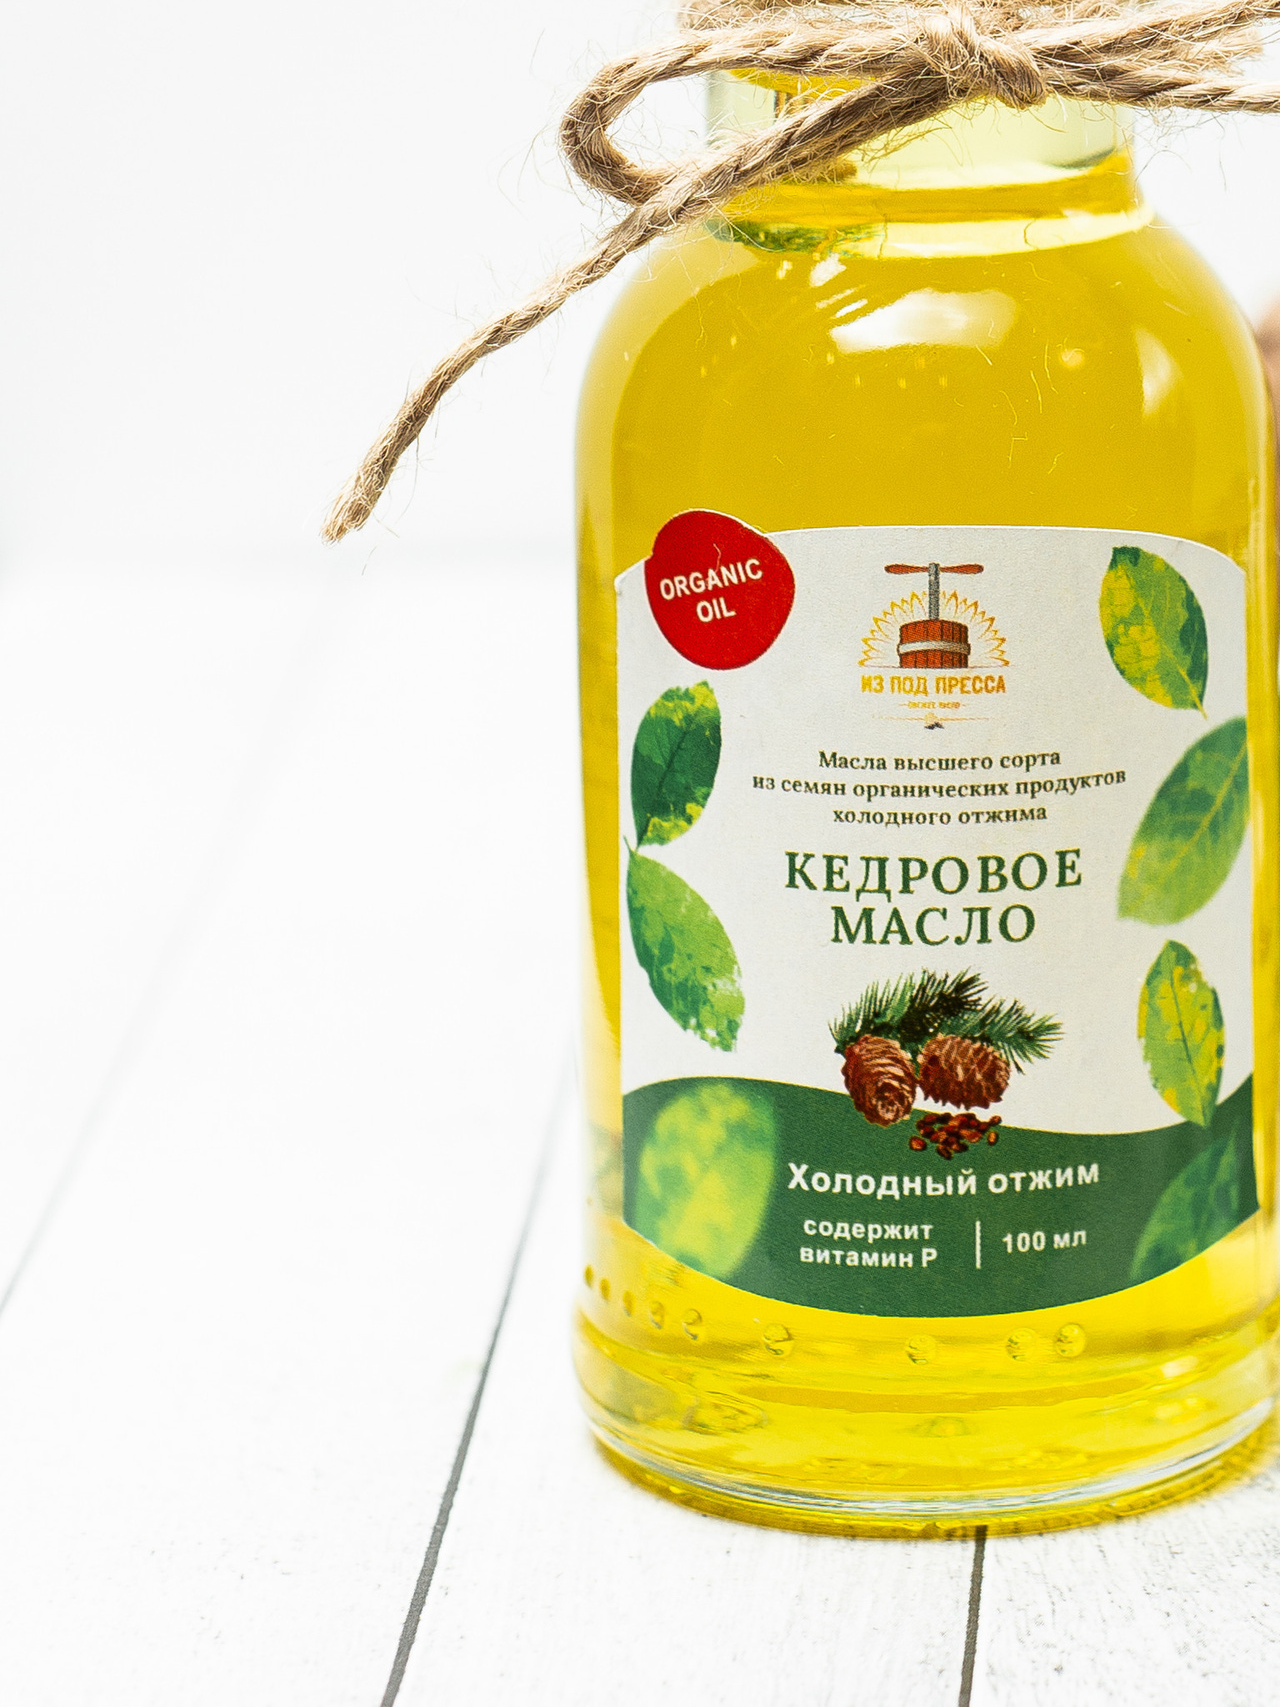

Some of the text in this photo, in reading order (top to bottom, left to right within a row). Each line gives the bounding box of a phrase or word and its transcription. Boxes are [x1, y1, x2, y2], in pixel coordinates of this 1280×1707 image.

[660, 558, 763, 601] ORGANIC
[696, 597, 737, 623] OIL
[861, 675, 1006, 697] ИЗ ПОД ПРЕССА
[818, 750, 1061, 772] Масла высшего сорта
[753, 768, 1126, 801] из семян органических продуктов
[833, 806, 1047, 828] холодного отжима
[785, 848, 1082, 902] КЕДРОВОЕ
[831, 903, 1036, 945] МАСЛО
[788, 1163, 1100, 1200] Холодный отжим
[803, 1219, 934, 1243] содержит
[1002, 1228, 1087, 1253] 100 мл
[799, 1245, 914, 1267] витамин
